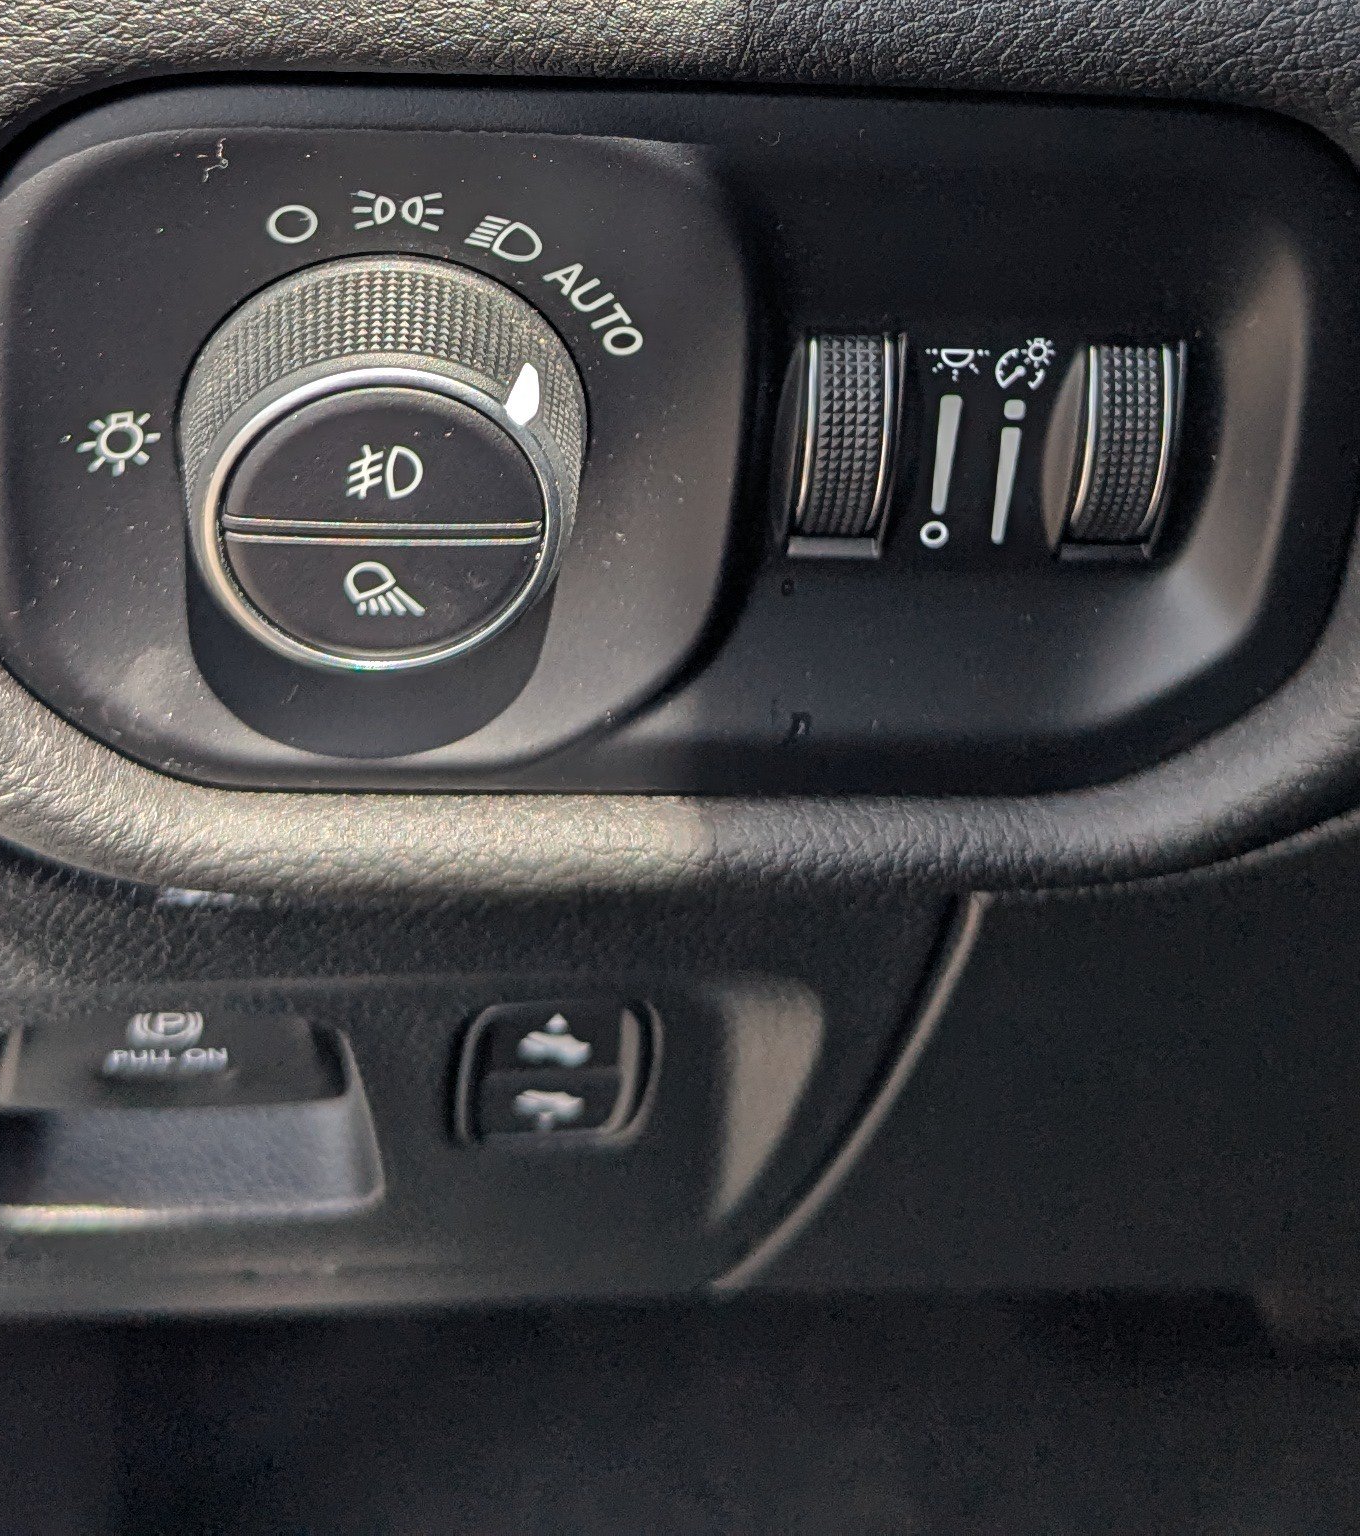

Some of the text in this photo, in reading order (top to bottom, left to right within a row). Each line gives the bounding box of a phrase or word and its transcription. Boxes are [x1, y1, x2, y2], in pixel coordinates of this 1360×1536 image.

[542, 263, 644, 356] AUTO
[105, 1047, 228, 1074] PULL ON
